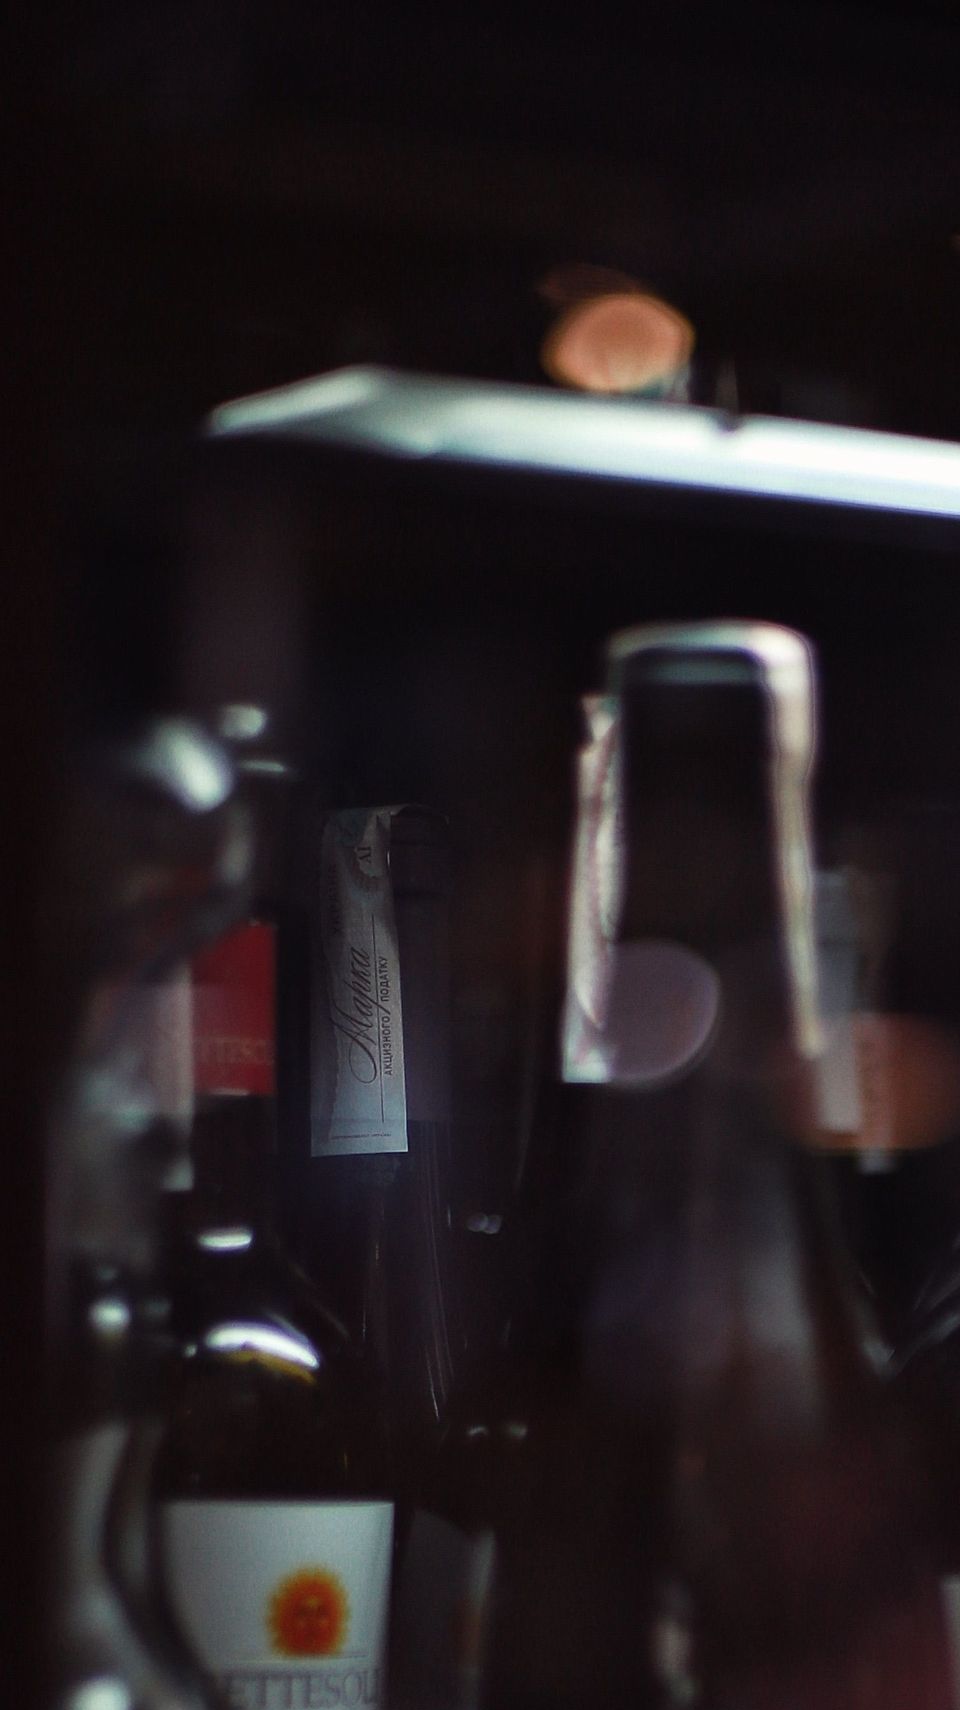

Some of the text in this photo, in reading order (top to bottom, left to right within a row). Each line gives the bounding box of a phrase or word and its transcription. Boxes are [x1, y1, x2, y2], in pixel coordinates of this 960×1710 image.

[329, 945, 391, 1084] Марка
[380, 955, 393, 1076] АКЦИЗНОГО ПОДАТКУ
